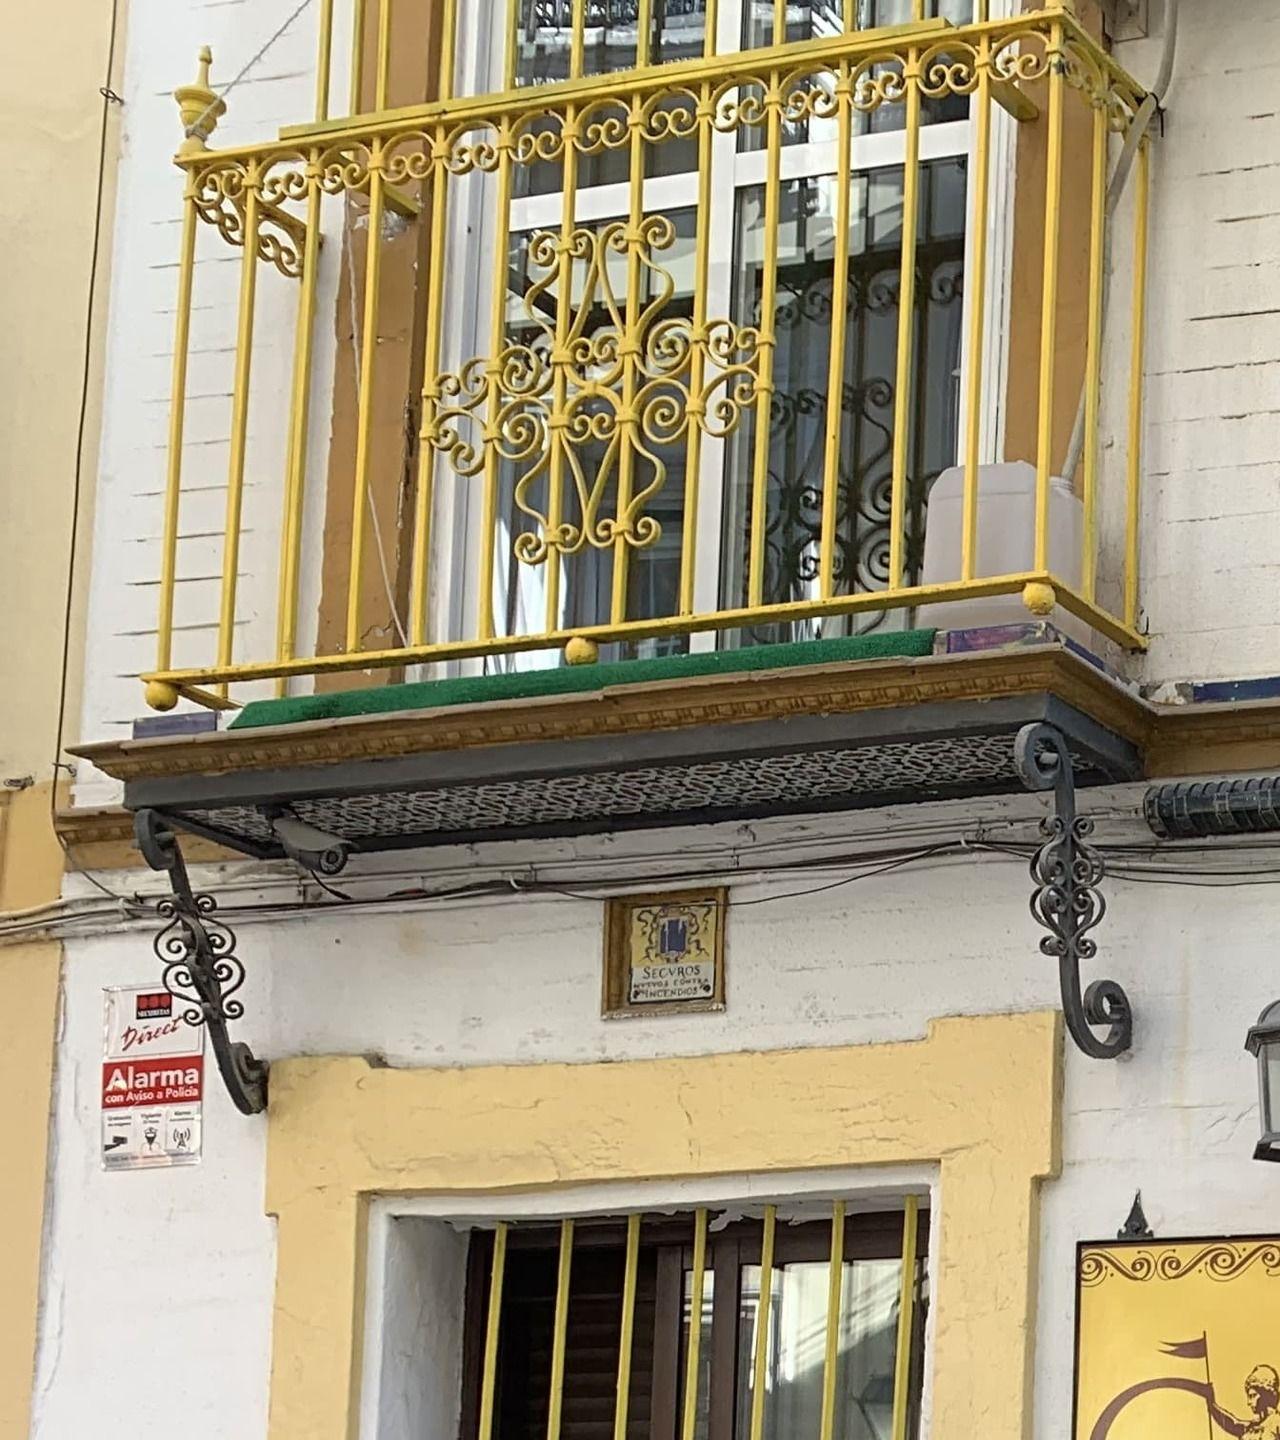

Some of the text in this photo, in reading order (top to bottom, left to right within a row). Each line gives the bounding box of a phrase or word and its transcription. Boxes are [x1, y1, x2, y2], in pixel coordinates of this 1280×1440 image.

[121, 1014, 183, 1052] Direct
[105, 1066, 199, 1091] Alarma
[105, 1094, 124, 1103] con
[126, 1090, 154, 1102] Aviso
[156, 1091, 163, 1099] a
